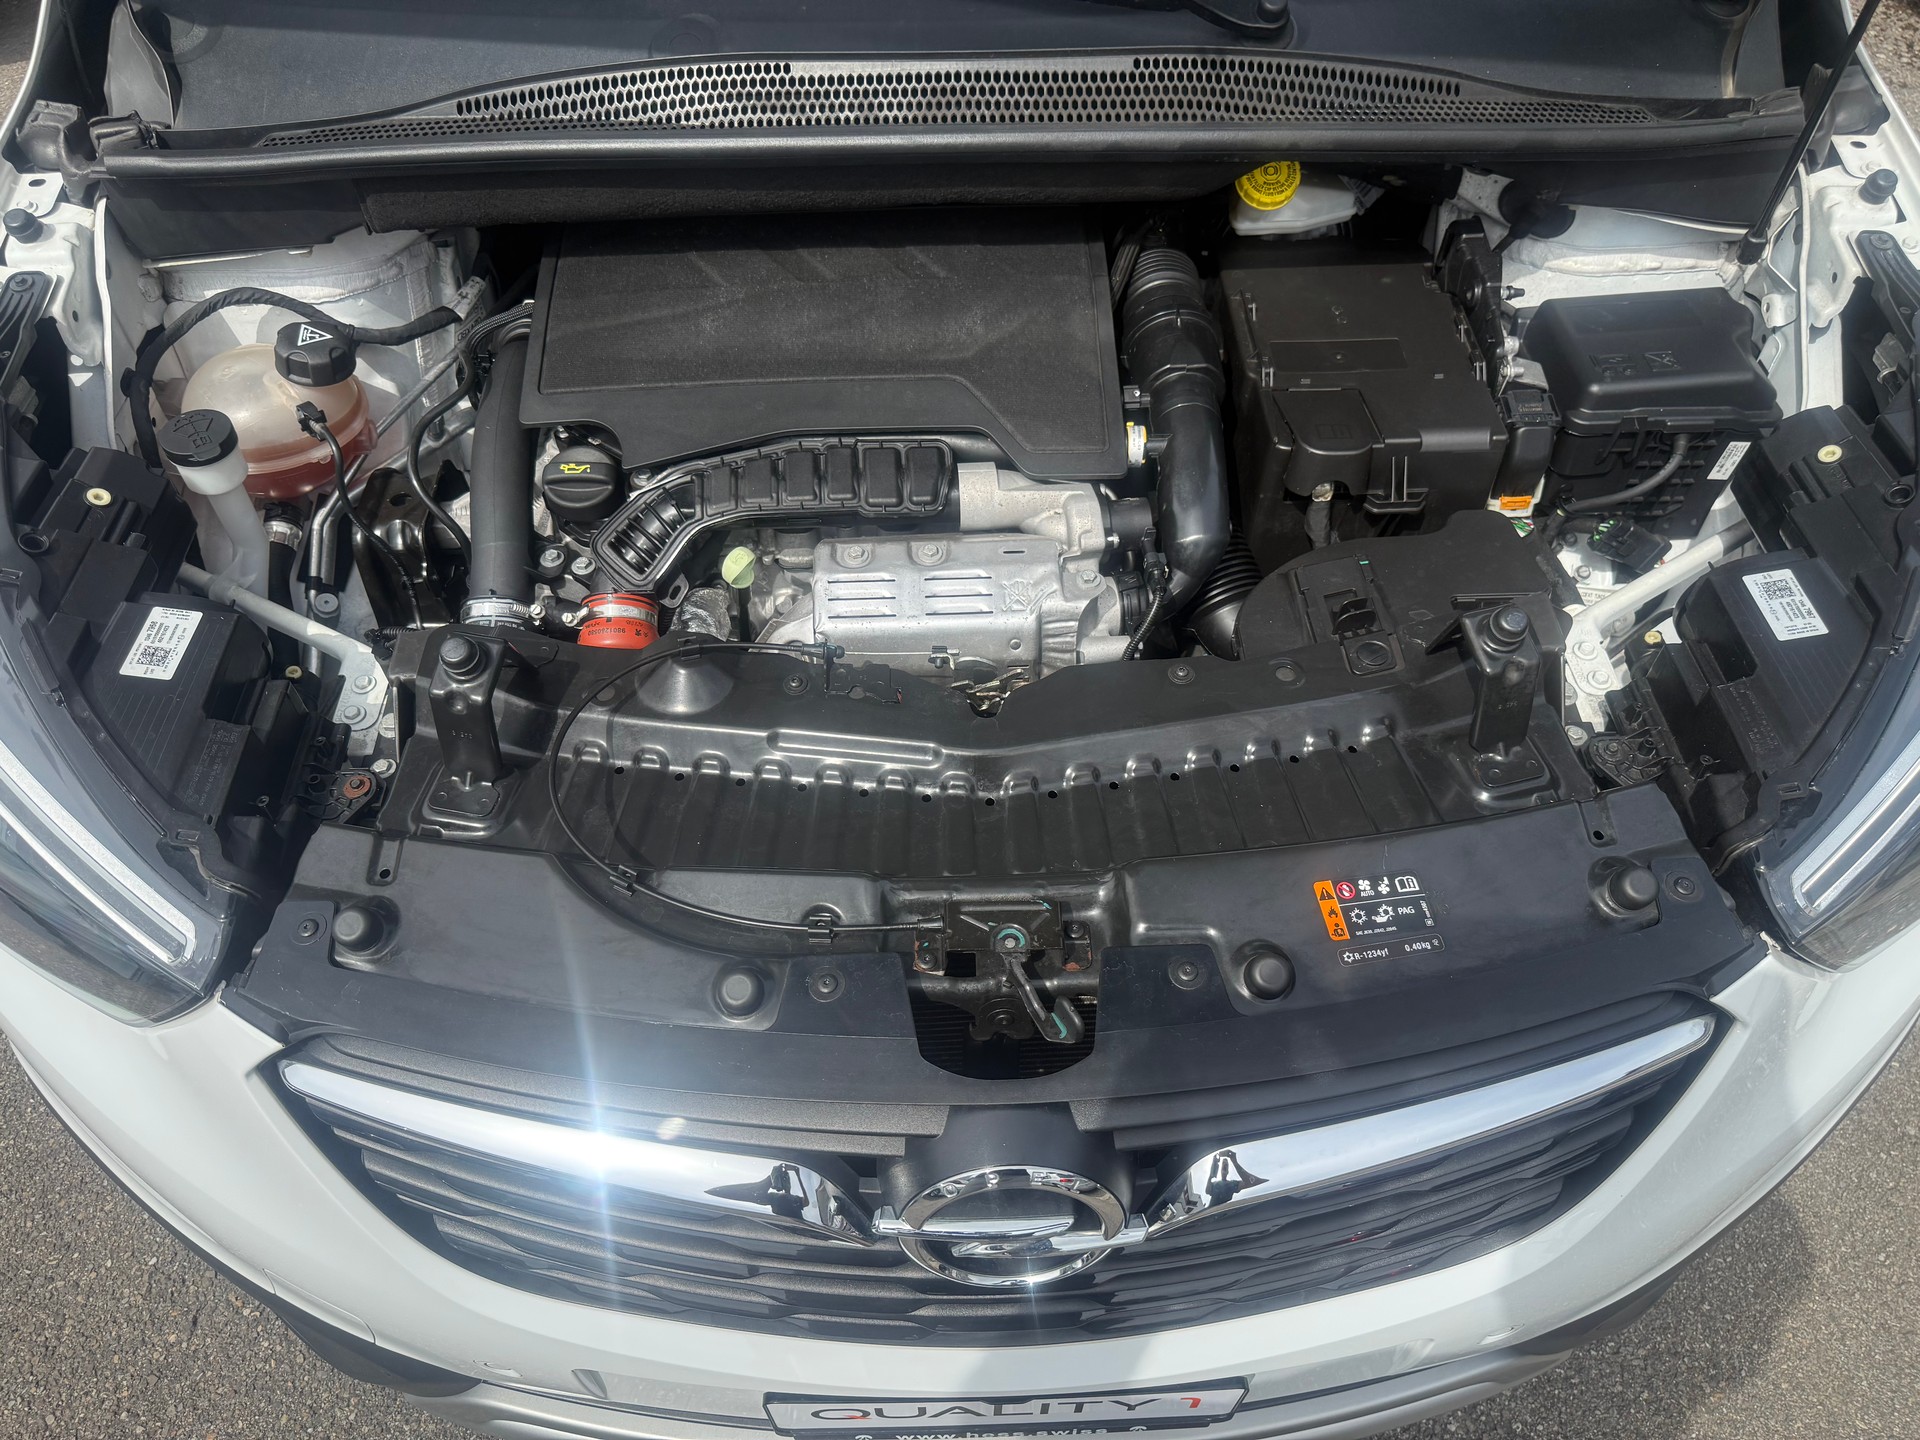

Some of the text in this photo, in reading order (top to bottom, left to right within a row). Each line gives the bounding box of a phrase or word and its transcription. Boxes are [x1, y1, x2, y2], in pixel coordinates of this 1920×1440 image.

[1360, 889, 1375, 897] AUTO
[1397, 906, 1415, 915] PAG
[1354, 947, 1389, 960] R-1234yf
[811, 1397, 1163, 1421] QUALITY
